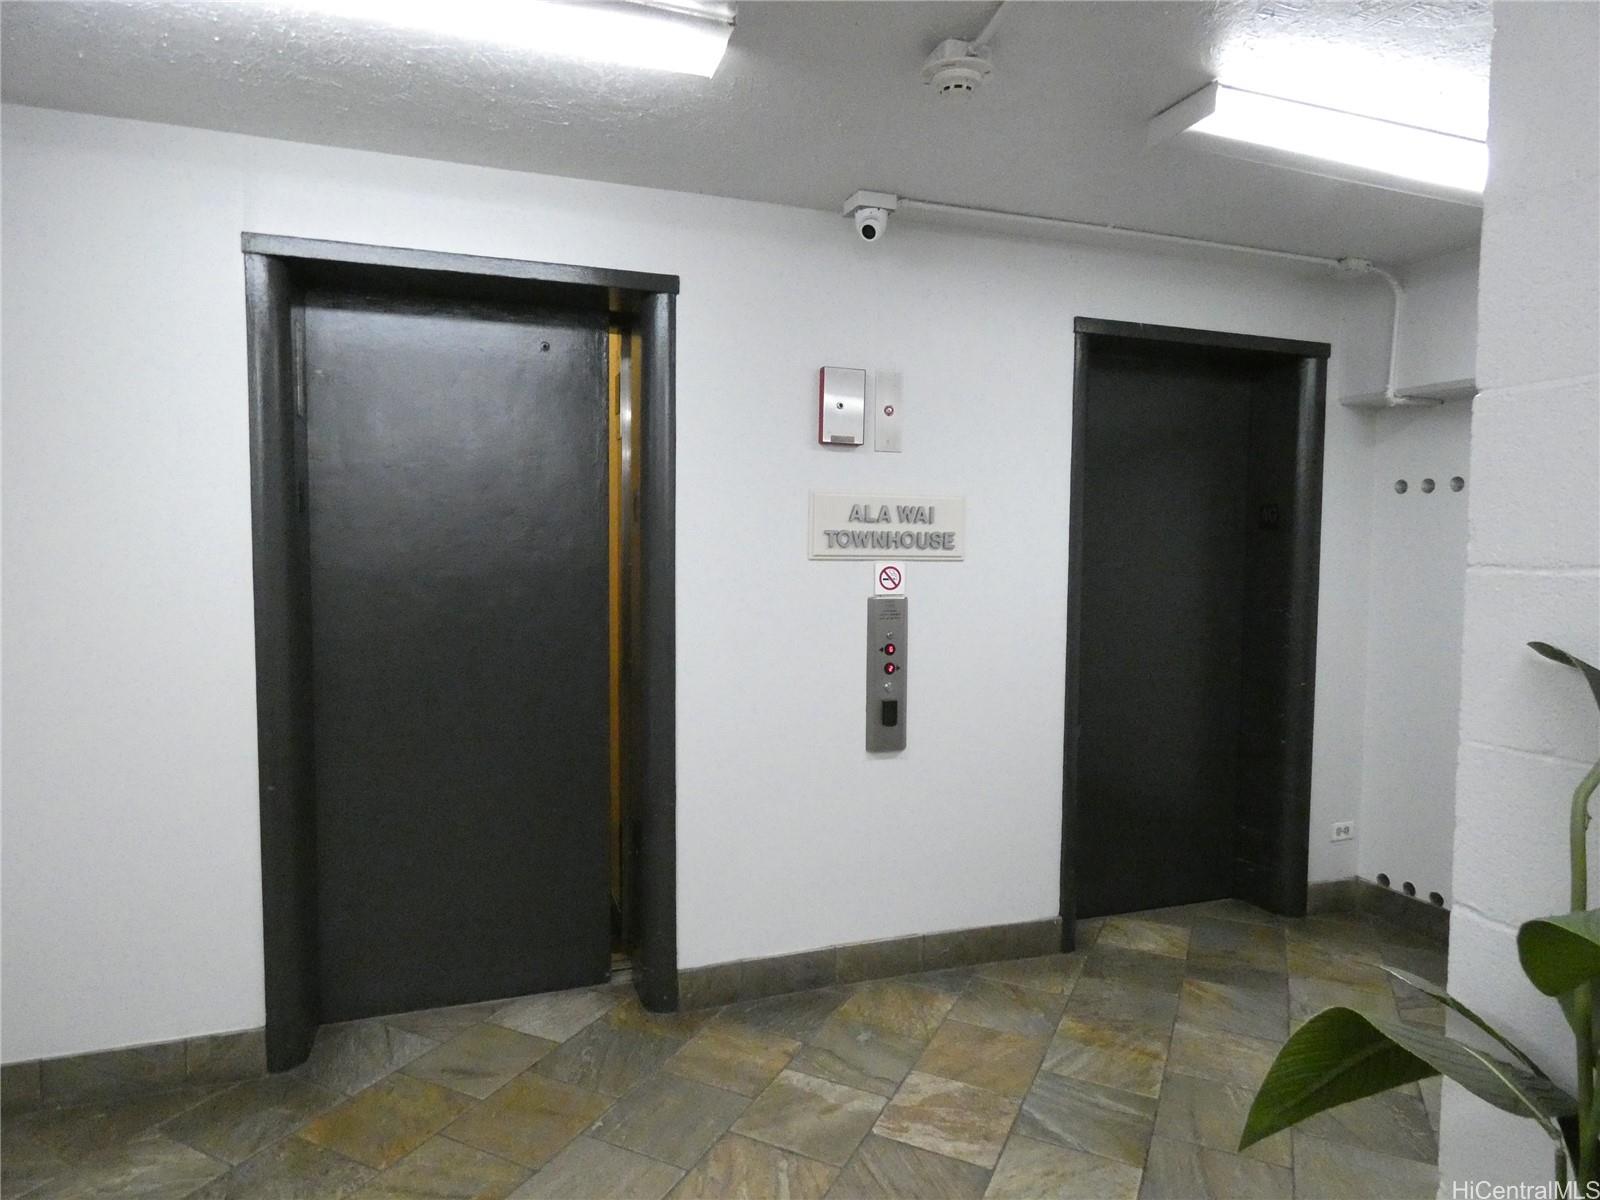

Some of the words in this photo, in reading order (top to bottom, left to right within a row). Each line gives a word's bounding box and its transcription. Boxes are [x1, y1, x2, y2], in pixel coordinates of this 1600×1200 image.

[848, 504, 892, 524] ALA
[896, 505, 936, 525] WAI
[824, 529, 957, 550] TOWNHOUSE
